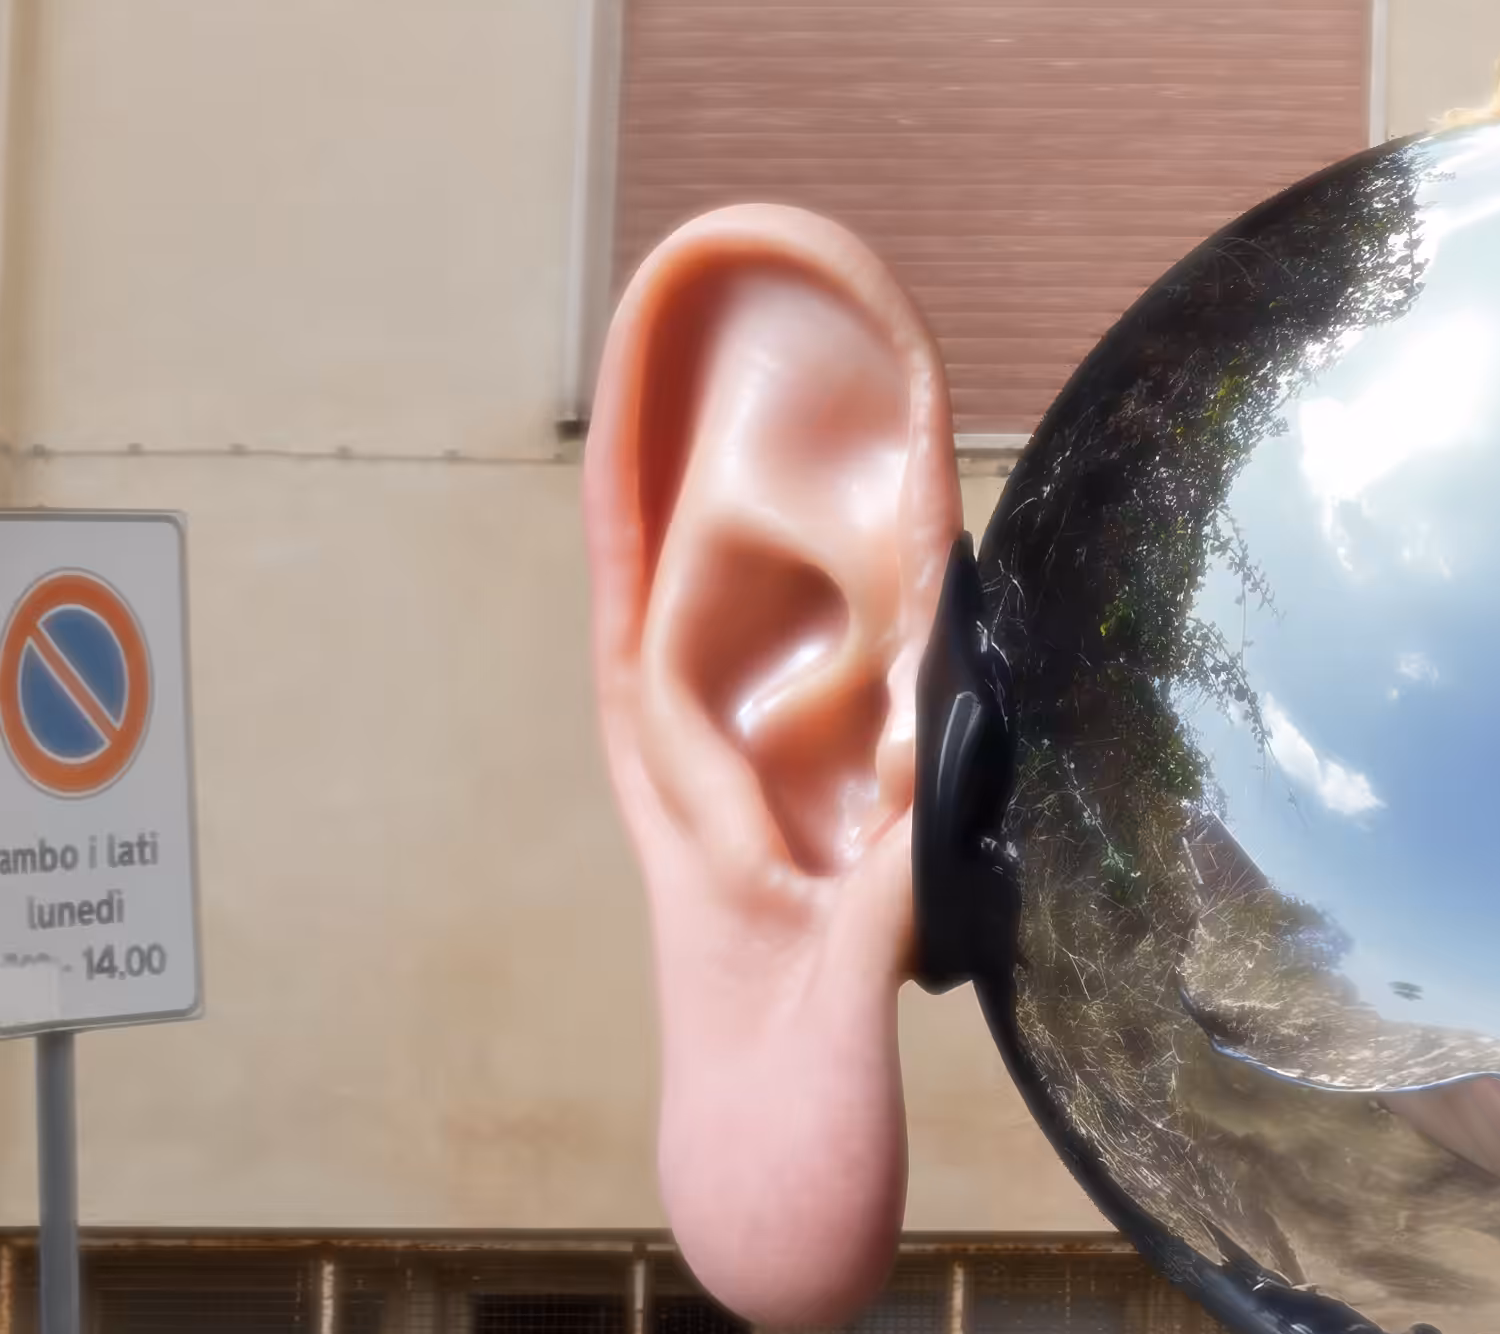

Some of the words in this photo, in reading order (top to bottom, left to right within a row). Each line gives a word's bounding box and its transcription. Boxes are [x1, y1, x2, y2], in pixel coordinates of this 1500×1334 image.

[0, 837, 79, 875] ambo
[88, 834, 98, 870] i
[106, 830, 159, 869] lati
[82, 943, 167, 980] 14.00
